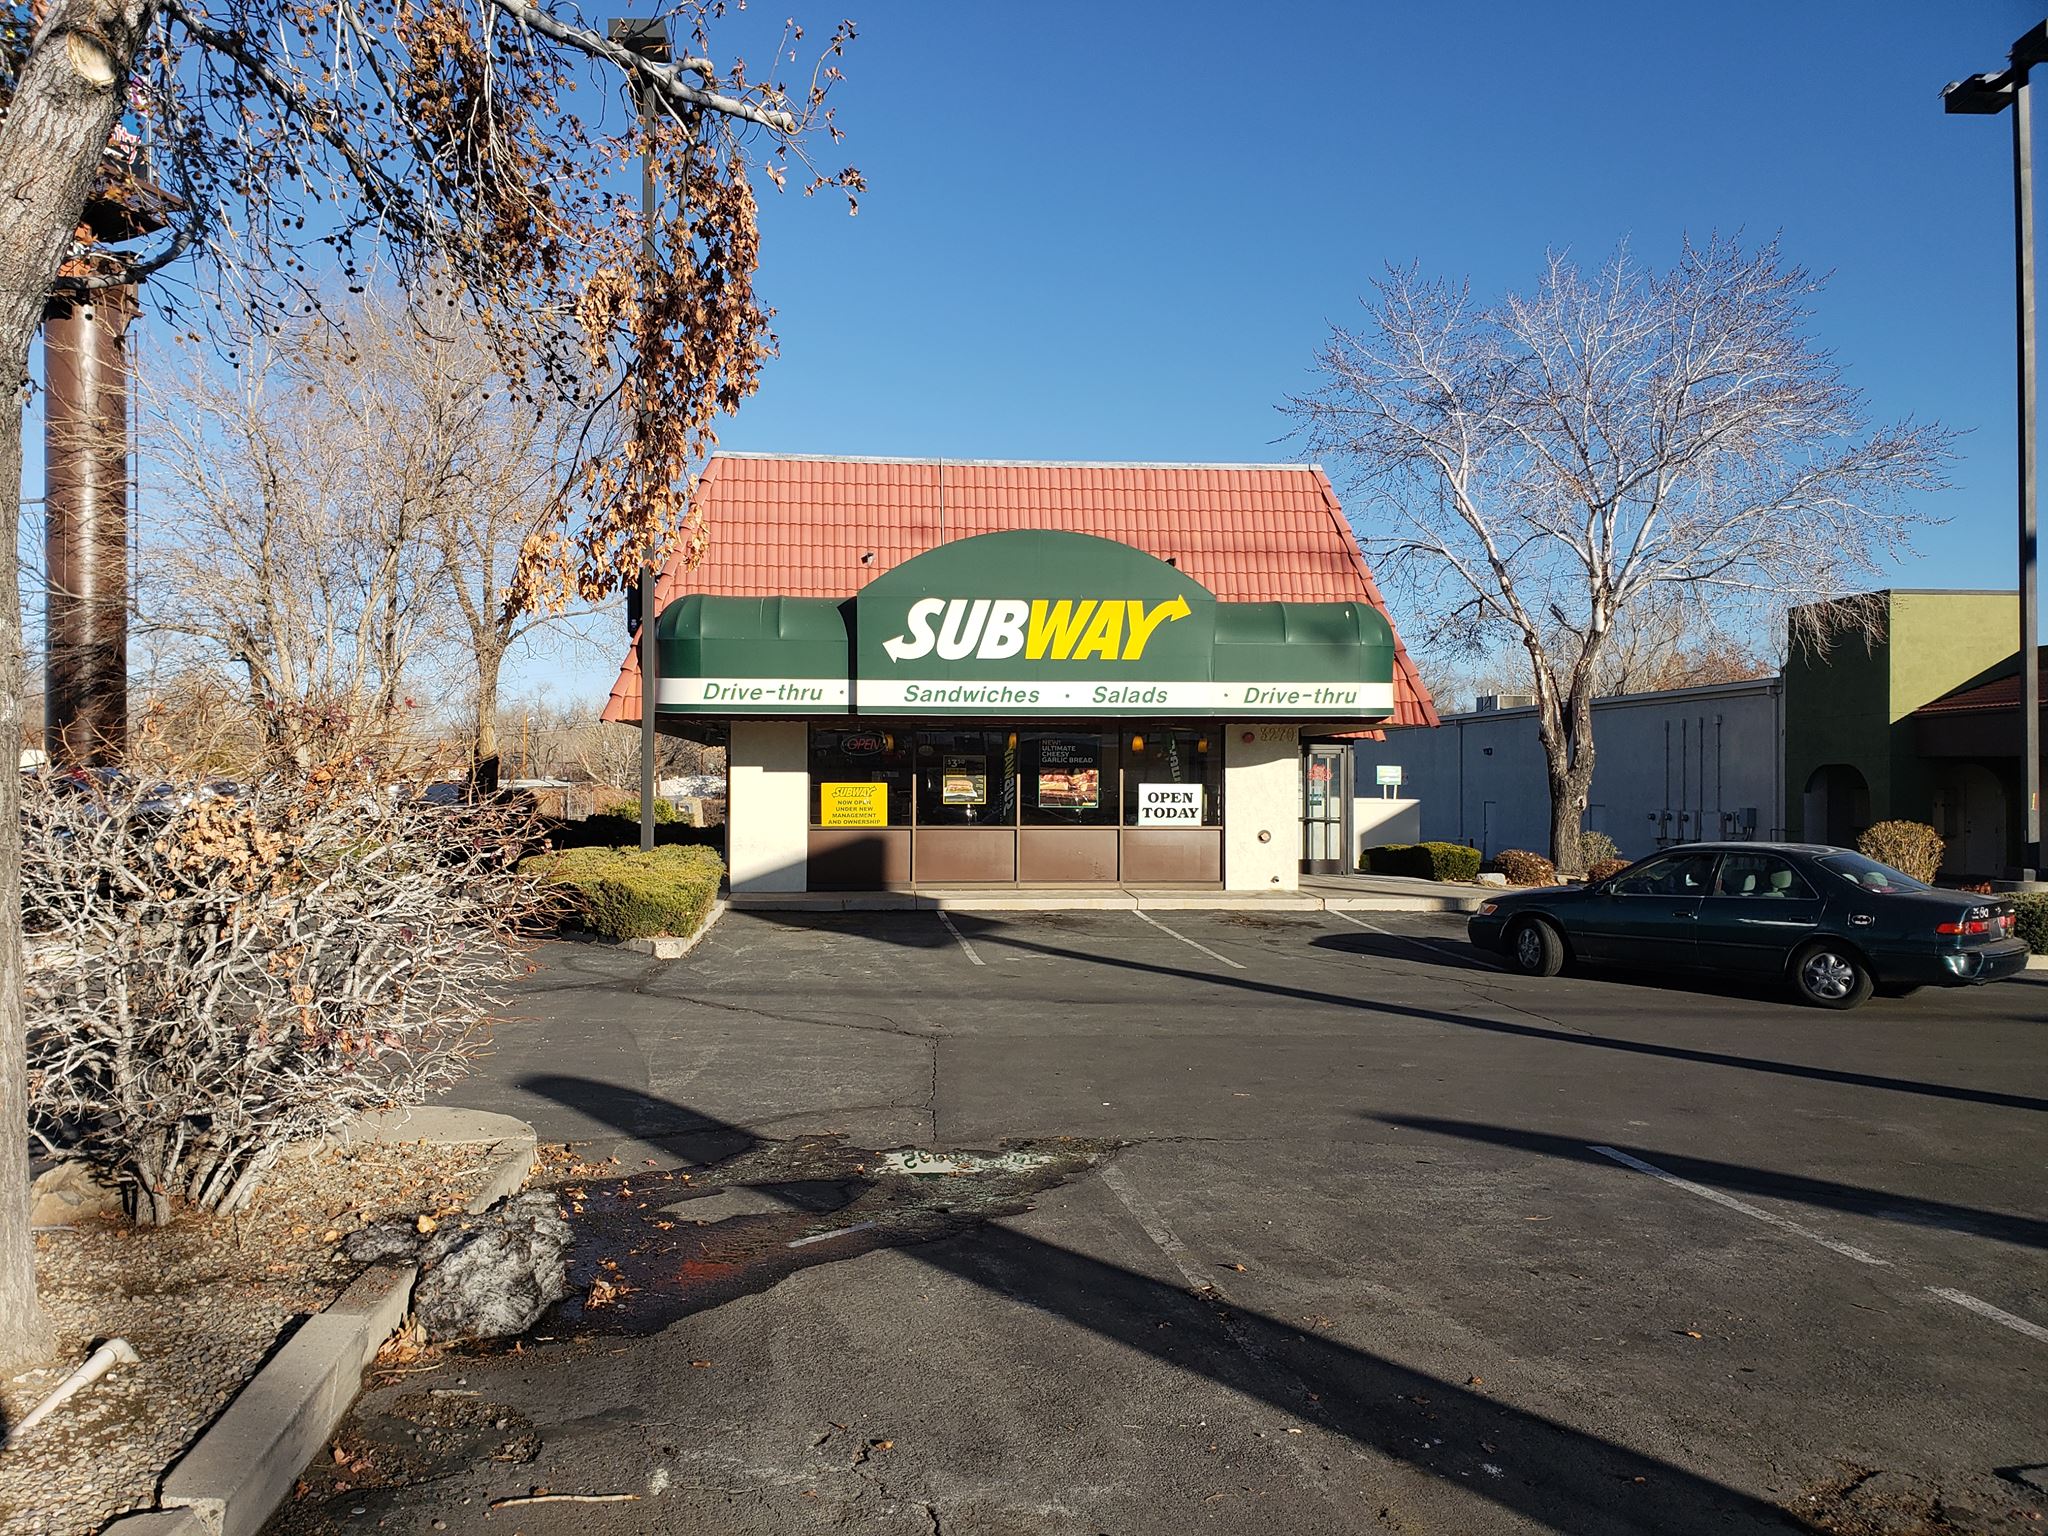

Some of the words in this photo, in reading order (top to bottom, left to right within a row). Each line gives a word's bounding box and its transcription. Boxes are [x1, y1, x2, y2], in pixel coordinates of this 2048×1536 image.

[882, 594, 1192, 664] SUBWAY
[703, 683, 823, 701] Drive-thru
[903, 684, 1040, 703] Sandwiches
[1092, 685, 1168, 704] Salads
[1243, 687, 1358, 704] Drive-thru
[847, 737, 881, 751] OPEN
[832, 785, 878, 798] SUBWAY
[1147, 792, 1194, 804] OPEN
[1142, 807, 1199, 818] TODAY
